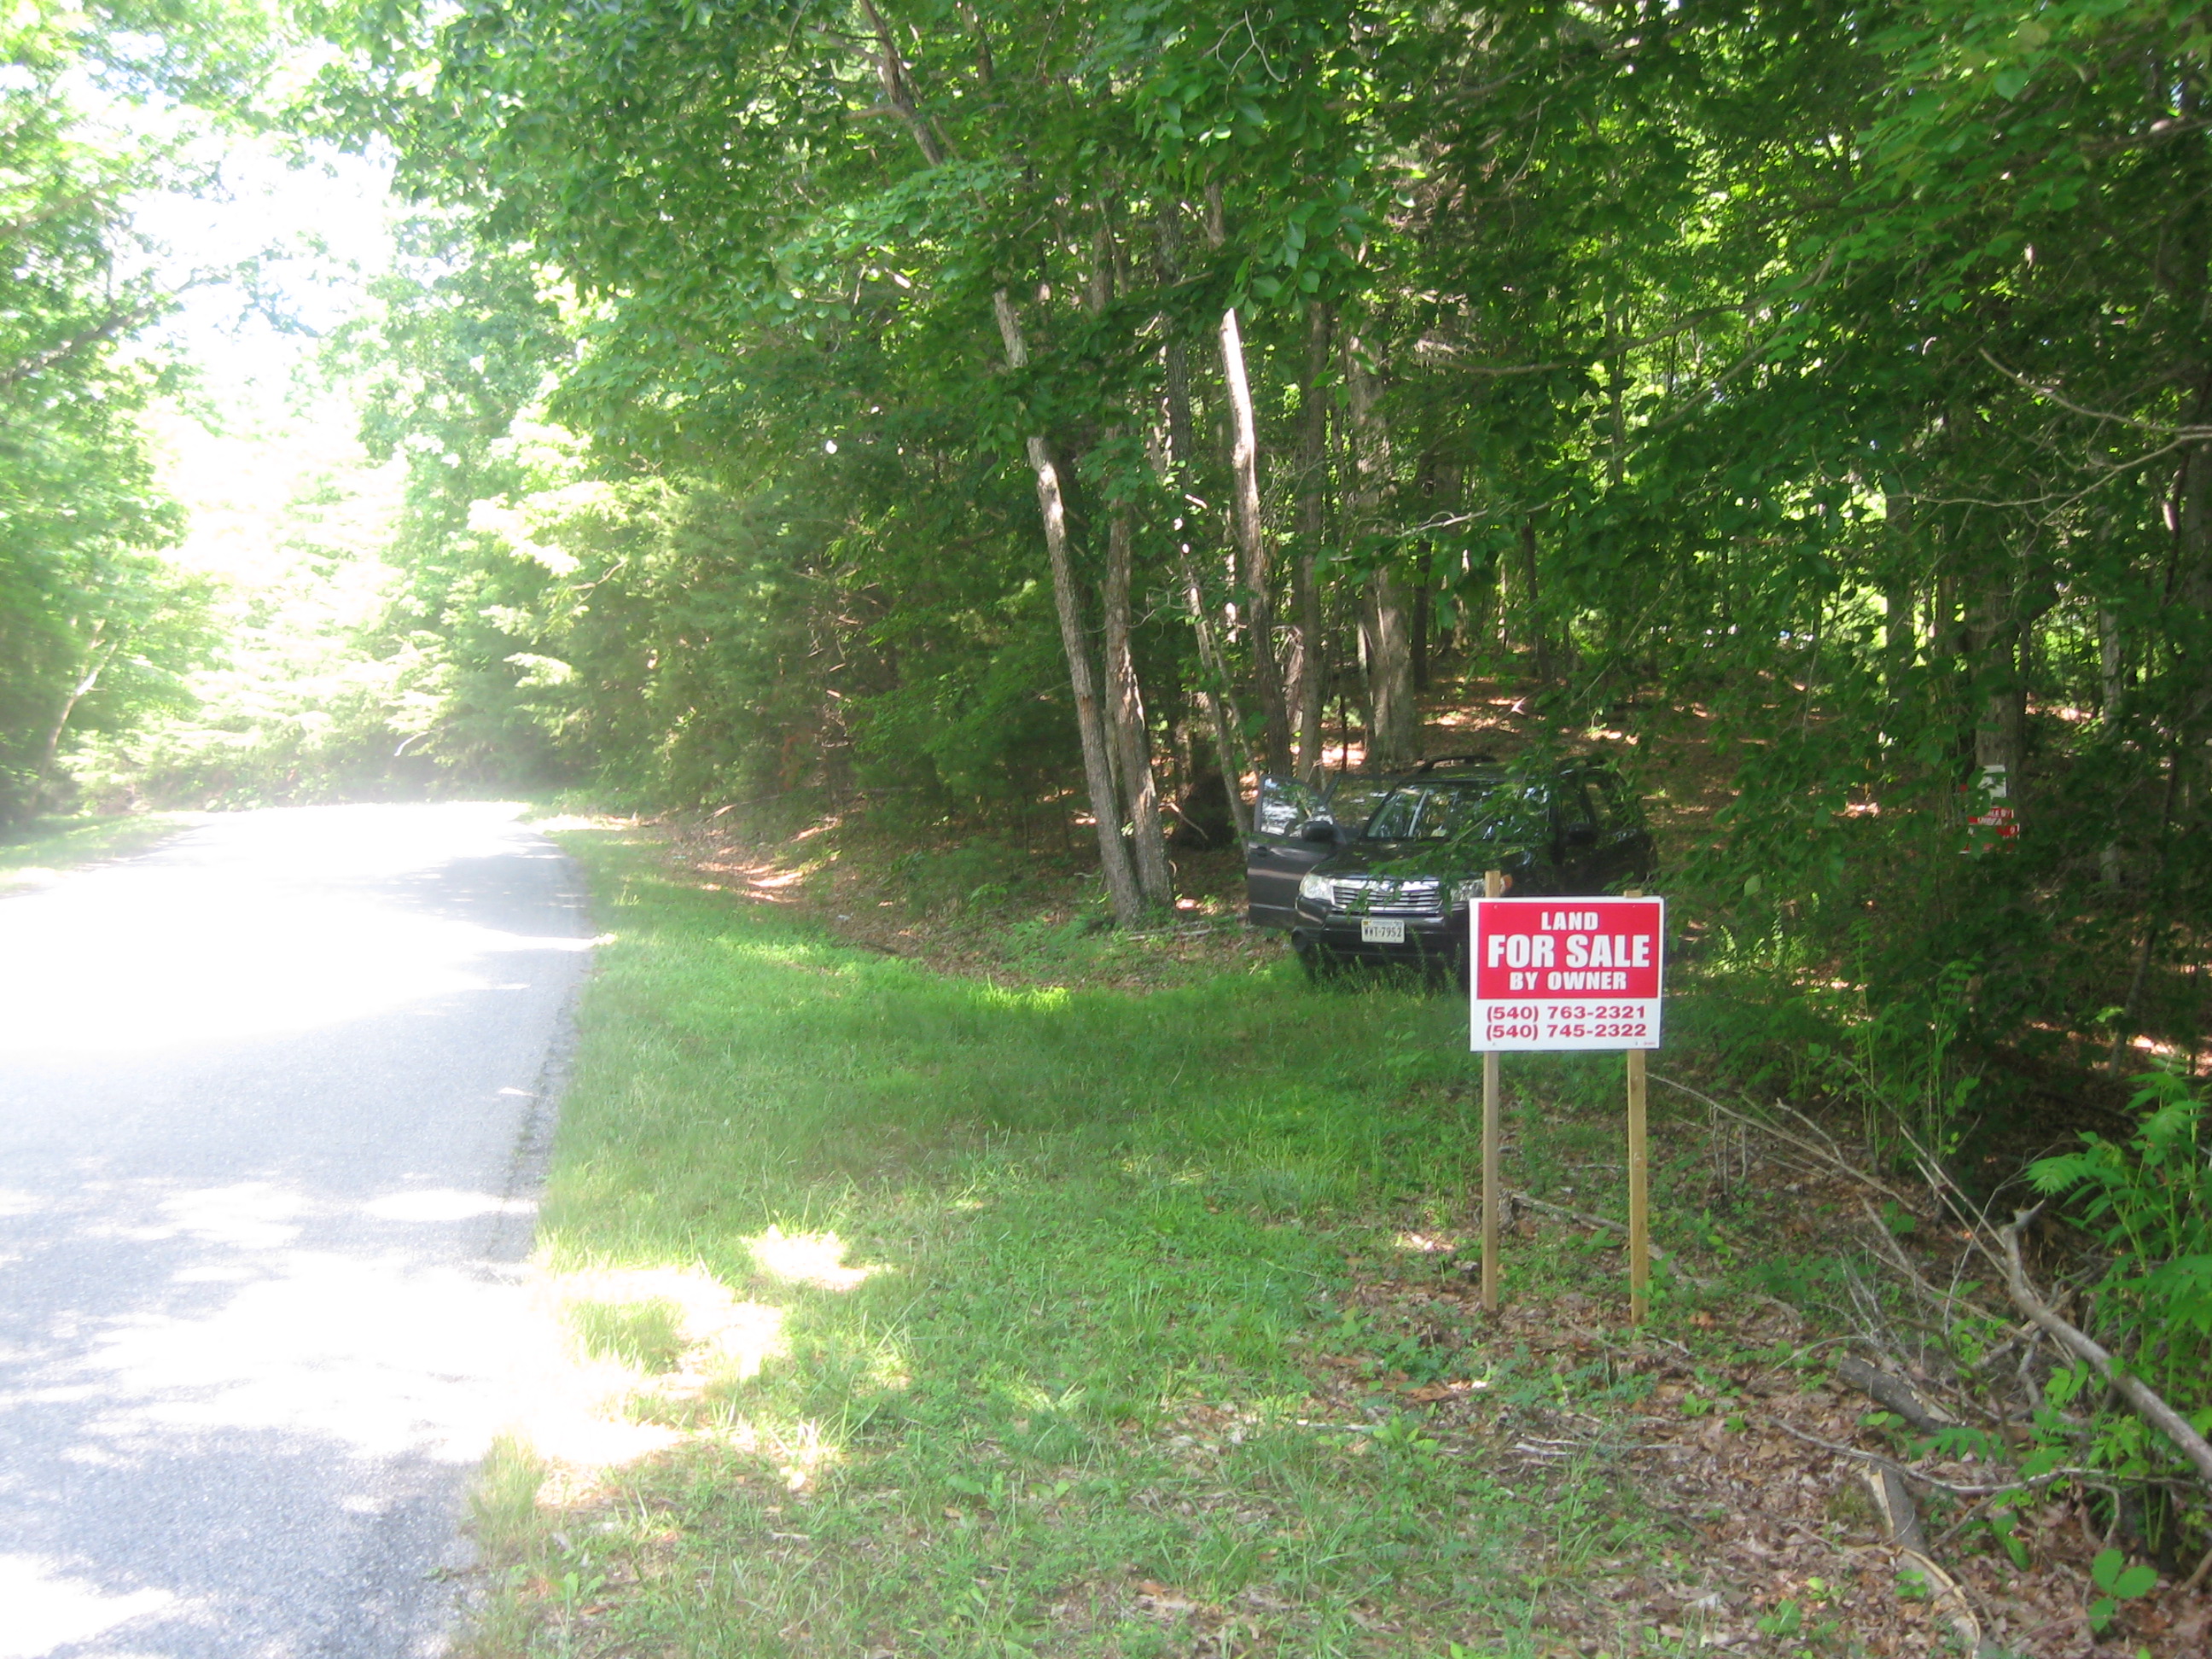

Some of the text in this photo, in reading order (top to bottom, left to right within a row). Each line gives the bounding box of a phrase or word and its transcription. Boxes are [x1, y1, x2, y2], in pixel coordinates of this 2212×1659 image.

[1540, 911, 1598, 930] LAND
[1487, 934, 1650, 969] FOR SALE
[1509, 971, 1627, 990] BY OWNER
[1487, 1005, 1645, 1022] (540) 763-2321
[1486, 1023, 1647, 1041] (540) 745-2322
